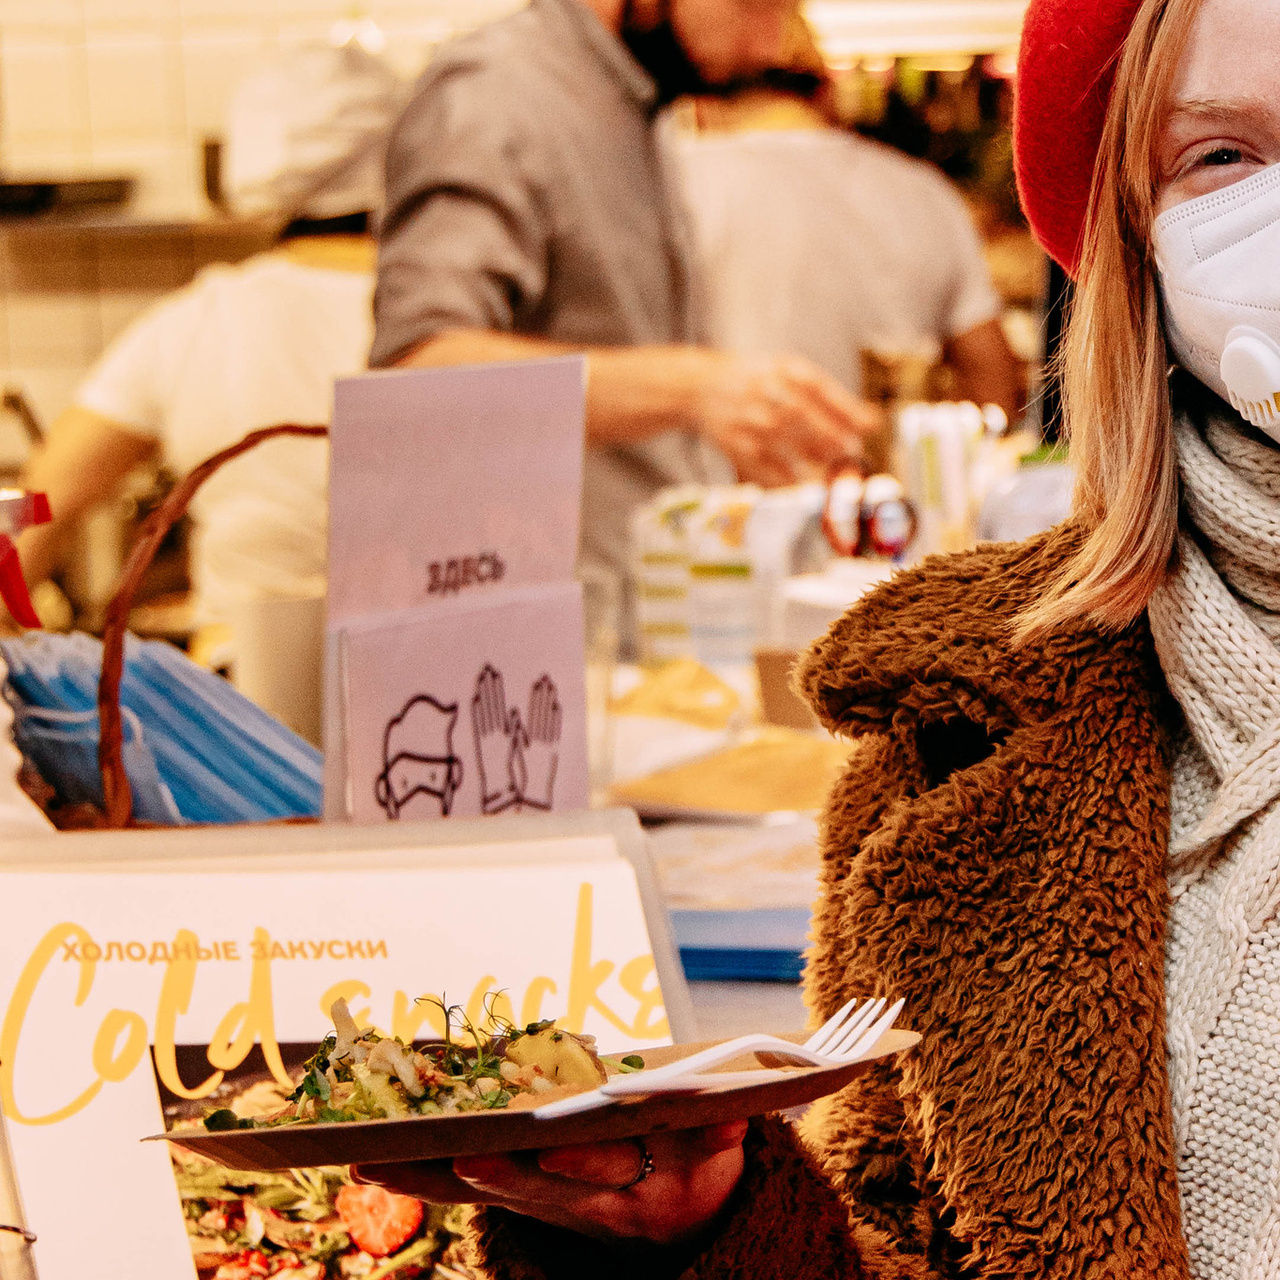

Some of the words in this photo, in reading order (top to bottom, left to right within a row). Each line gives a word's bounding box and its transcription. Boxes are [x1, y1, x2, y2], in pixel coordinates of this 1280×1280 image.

[427, 553, 505, 596] ЗДЕСЬ
[62, 940, 241, 965] ХОЛОДНЫЕ
[249, 938, 389, 962] ЗАКУСКИ
[0, 921, 296, 1127] Cold
